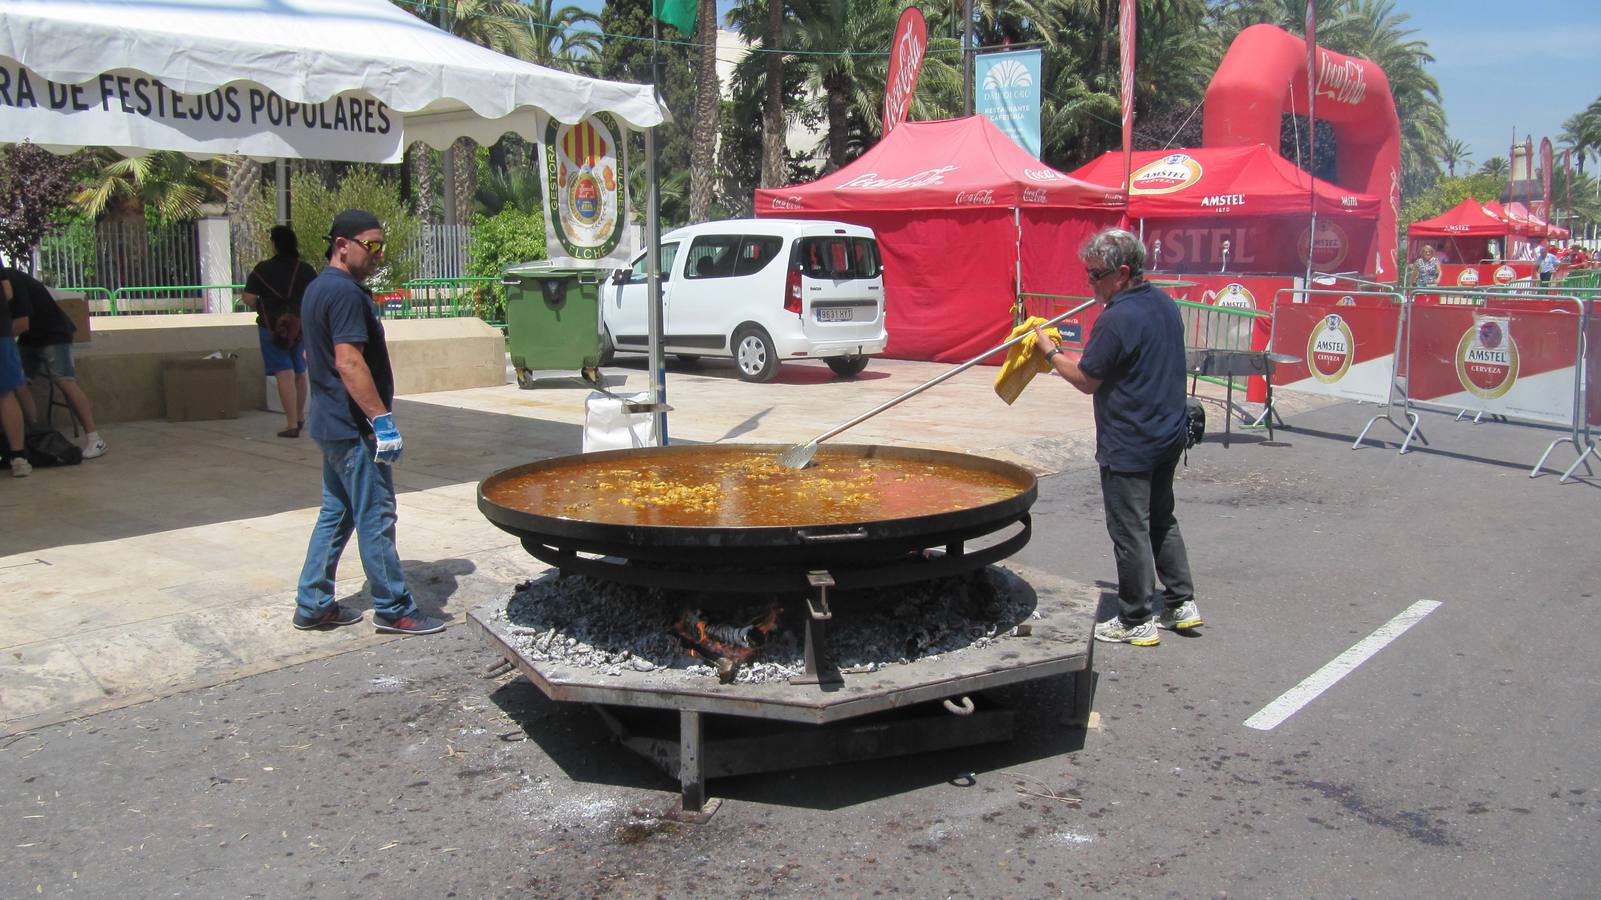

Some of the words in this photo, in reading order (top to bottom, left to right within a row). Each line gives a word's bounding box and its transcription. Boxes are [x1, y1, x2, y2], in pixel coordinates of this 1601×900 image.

[48, 81, 89, 111] DE
[99, 74, 241, 123] FESTEJOS
[249, 88, 391, 134] POPULARES
[546, 145, 558, 211] GESTORA
[616, 140, 625, 216] POPULARES
[1142, 170, 1187, 179] AMSTEL
[1200, 195, 1246, 207] AMSTEL
[569, 246, 608, 259] ELCHE
[1316, 340, 1345, 352] AMSTEL
[1317, 354, 1340, 362] CERVEZA
[1468, 349, 1507, 363] AMSTEL
[1471, 365, 1502, 374] CERVEZA
